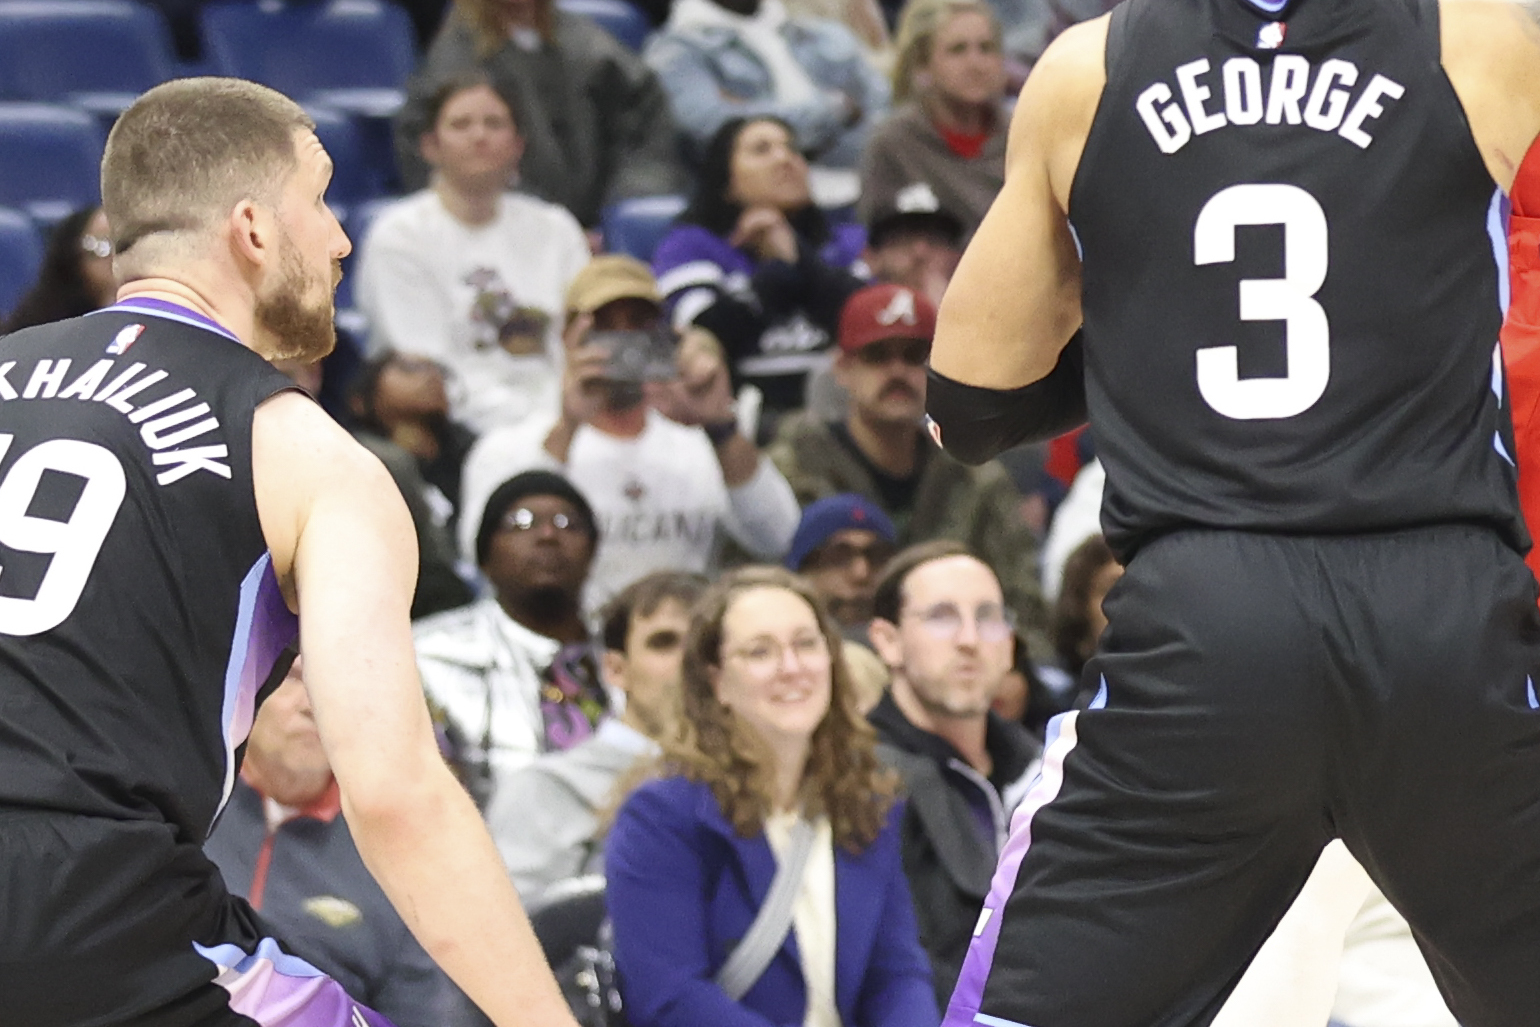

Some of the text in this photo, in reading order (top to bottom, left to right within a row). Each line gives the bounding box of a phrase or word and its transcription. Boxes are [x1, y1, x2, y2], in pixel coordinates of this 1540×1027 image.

[1135, 54, 1406, 154] GEORGE
[1193, 182, 1331, 420] 3
[0, 433, 127, 637] 9
